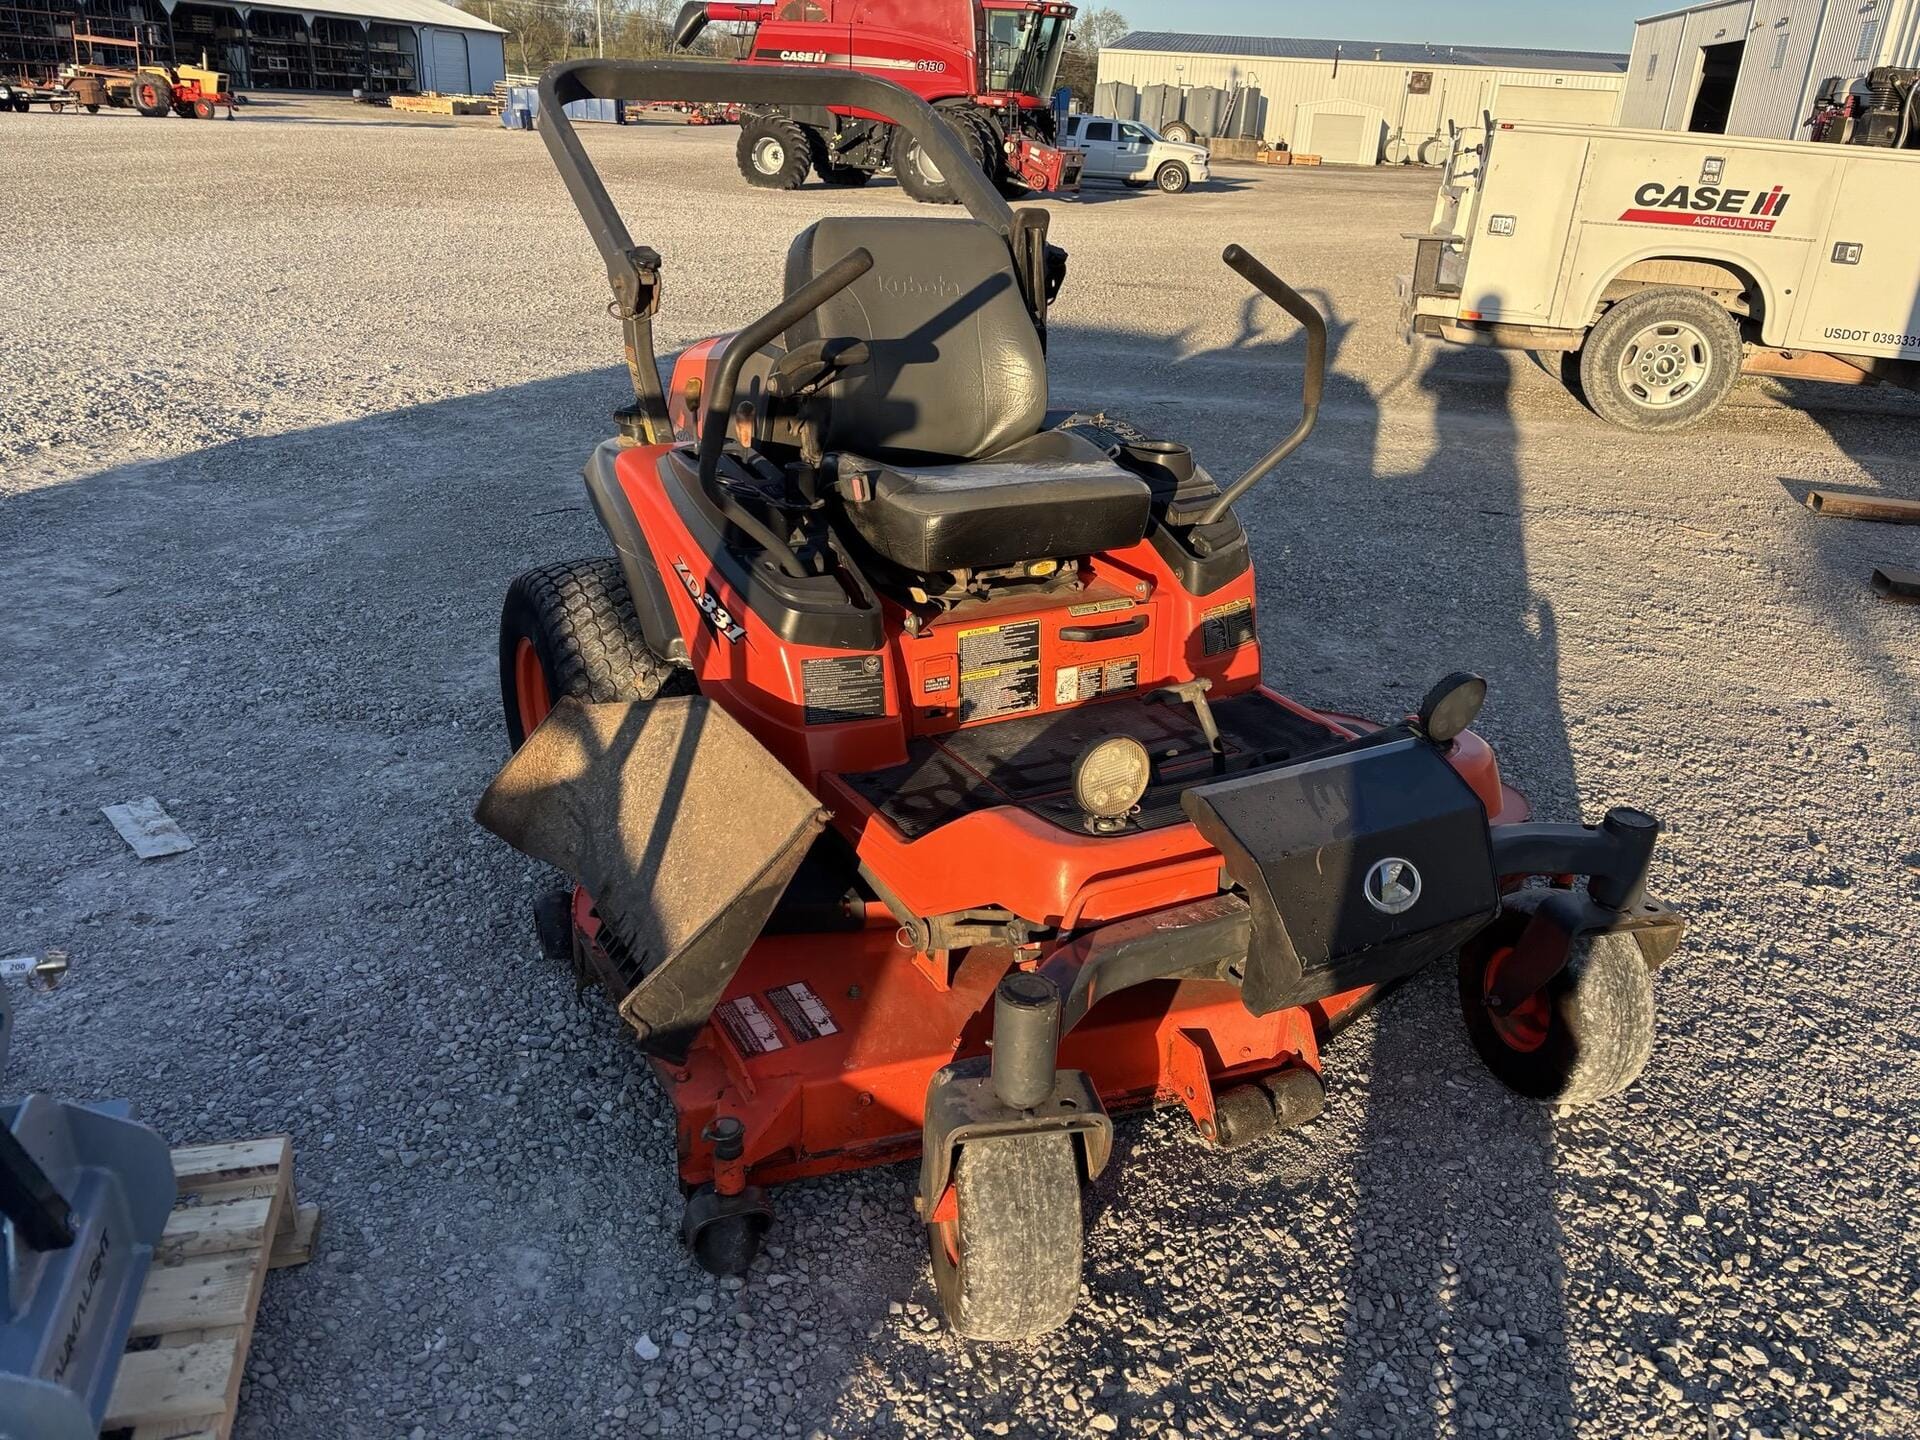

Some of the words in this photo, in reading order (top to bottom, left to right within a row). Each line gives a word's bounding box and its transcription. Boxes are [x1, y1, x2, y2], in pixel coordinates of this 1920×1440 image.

[780, 50, 814, 63] CASE
[916, 60, 946, 73] 6130
[1634, 182, 1750, 214] CASE
[1692, 215, 1771, 232] AGRICULTURE
[878, 274, 961, 297] Kubota
[1823, 327, 1871, 343] USDOT
[10, 963, 26, 971] 200
